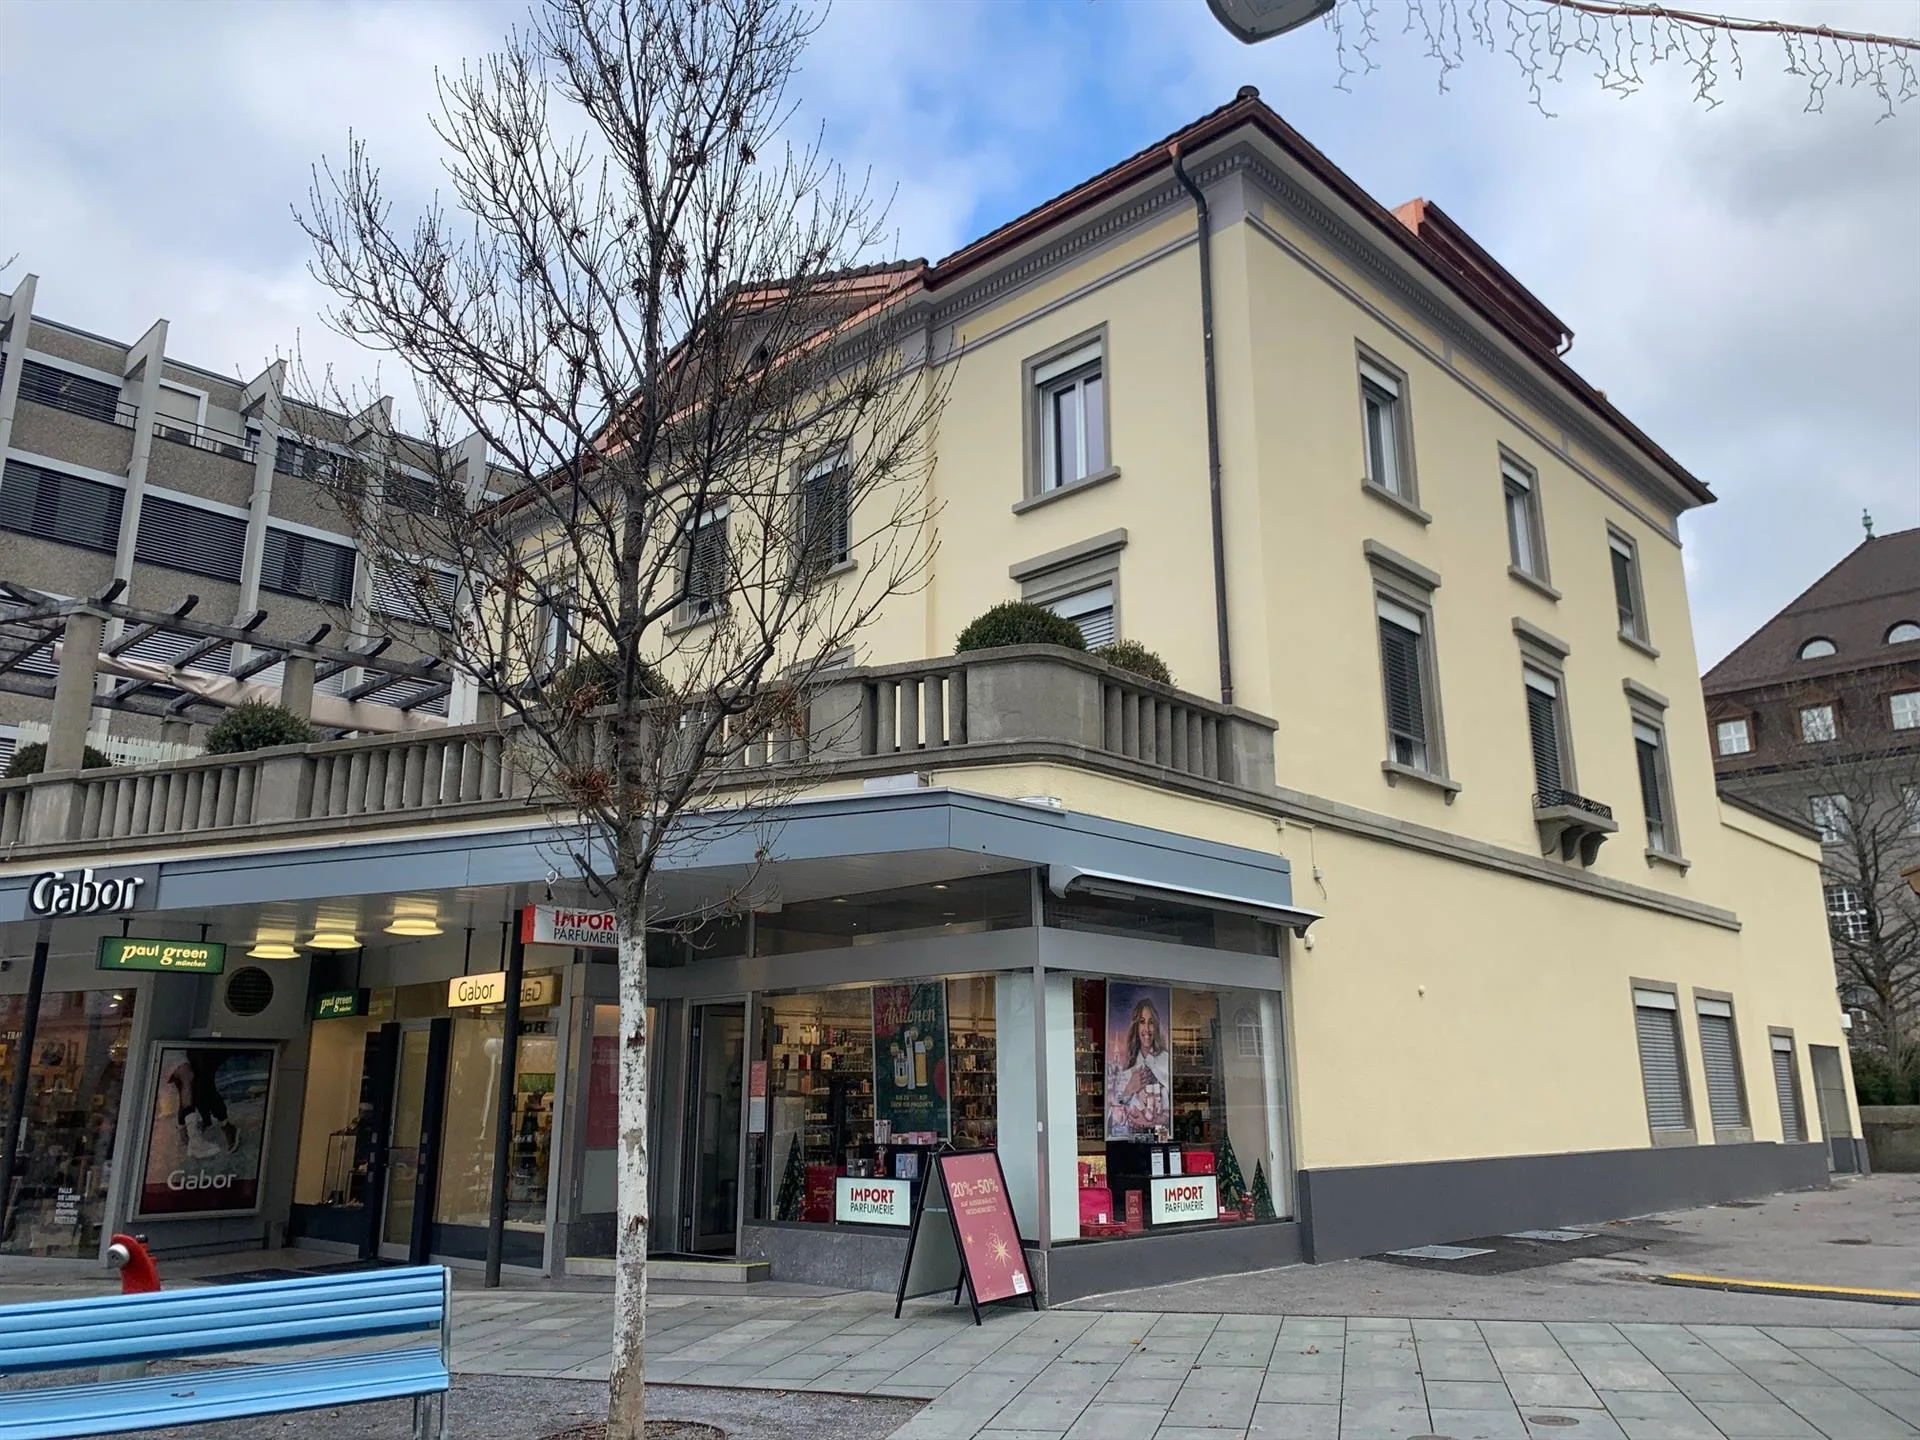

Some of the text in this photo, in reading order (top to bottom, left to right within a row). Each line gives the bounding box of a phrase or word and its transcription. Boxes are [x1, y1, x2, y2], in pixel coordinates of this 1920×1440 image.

[29, 868, 144, 916] Gabor
[554, 910, 618, 931] IMPOR
[553, 928, 619, 945] PARFUMERI
[120, 944, 208, 966] paul green
[458, 980, 495, 1002] Gabor
[167, 1169, 237, 1191] Gabor
[850, 1187, 894, 1204] IMPORT
[1164, 1186, 1204, 1202] IMPORT
[850, 1202, 894, 1216] PARFUMERIE
[1165, 1200, 1204, 1213] PARFUMERIE
